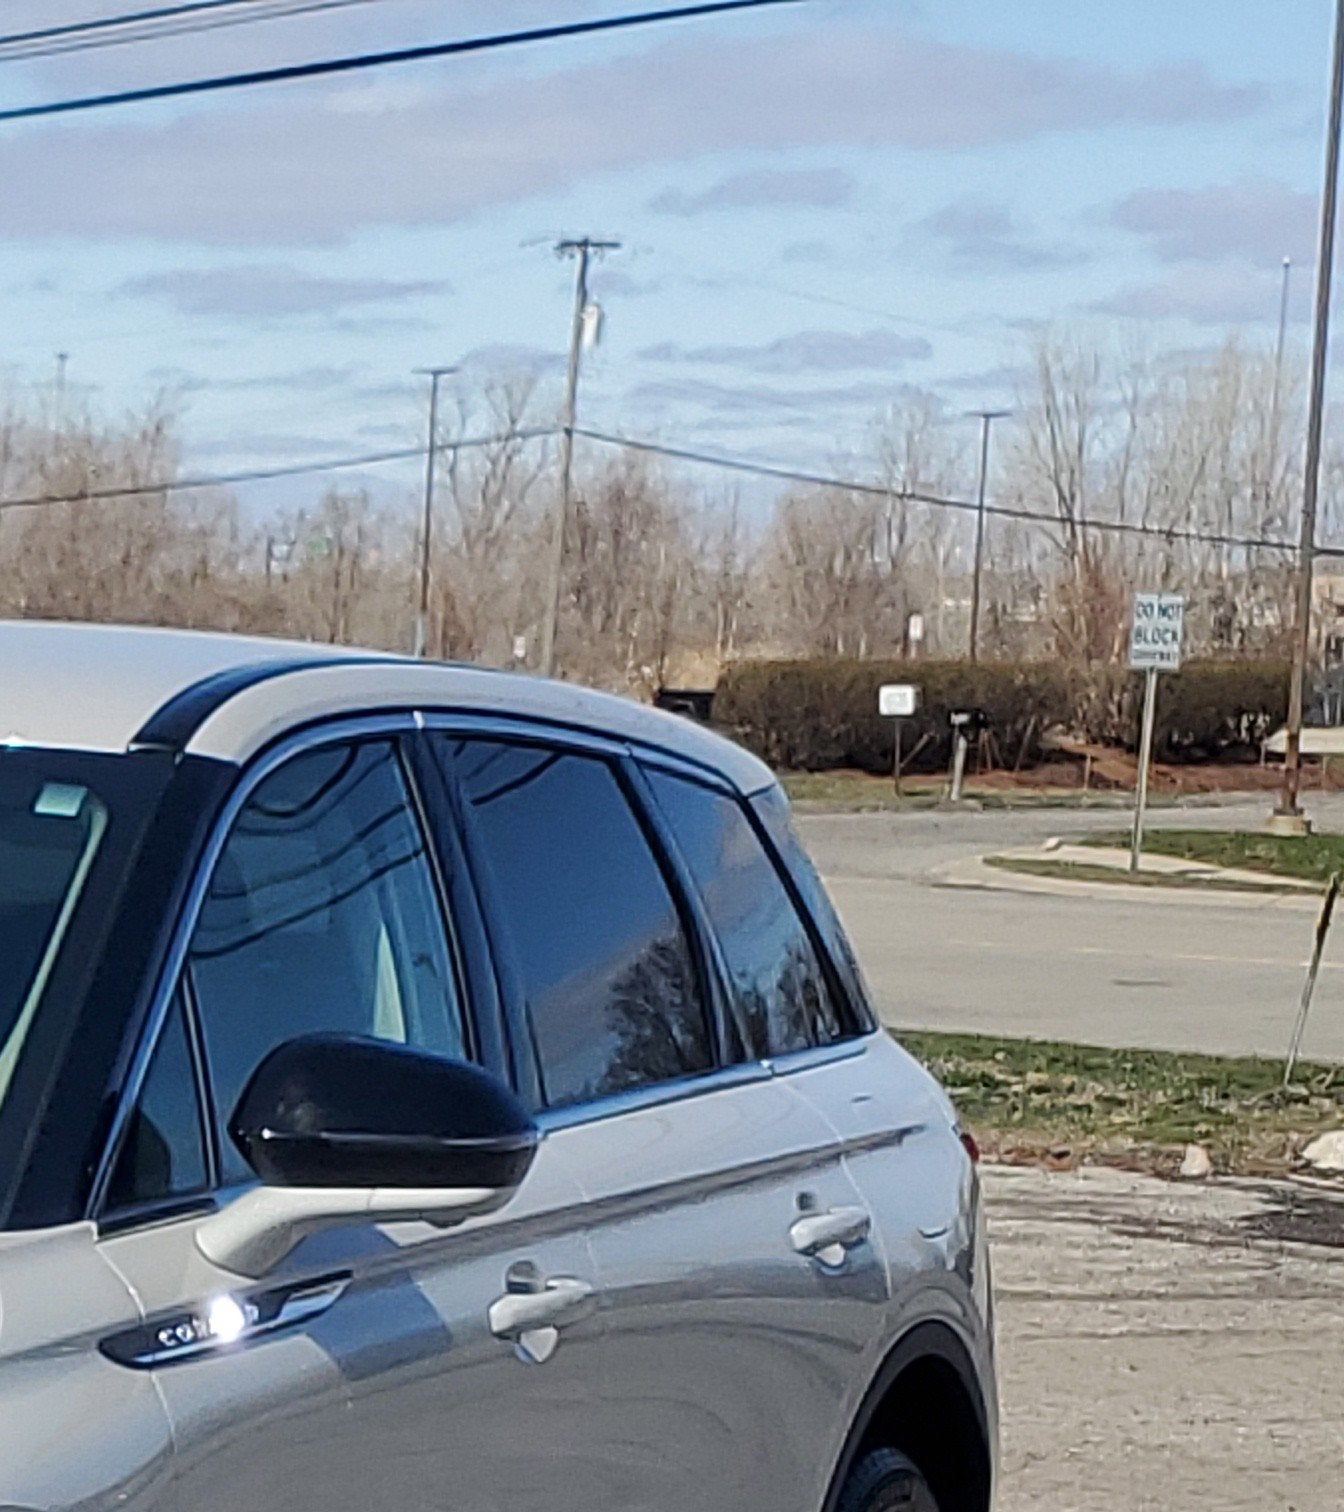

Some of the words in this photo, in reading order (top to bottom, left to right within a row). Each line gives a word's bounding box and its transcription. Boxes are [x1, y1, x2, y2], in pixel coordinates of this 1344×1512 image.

[1137, 602, 1154, 619] DO
[1158, 603, 1181, 619] NOT
[1134, 625, 1178, 645] BLOCK
